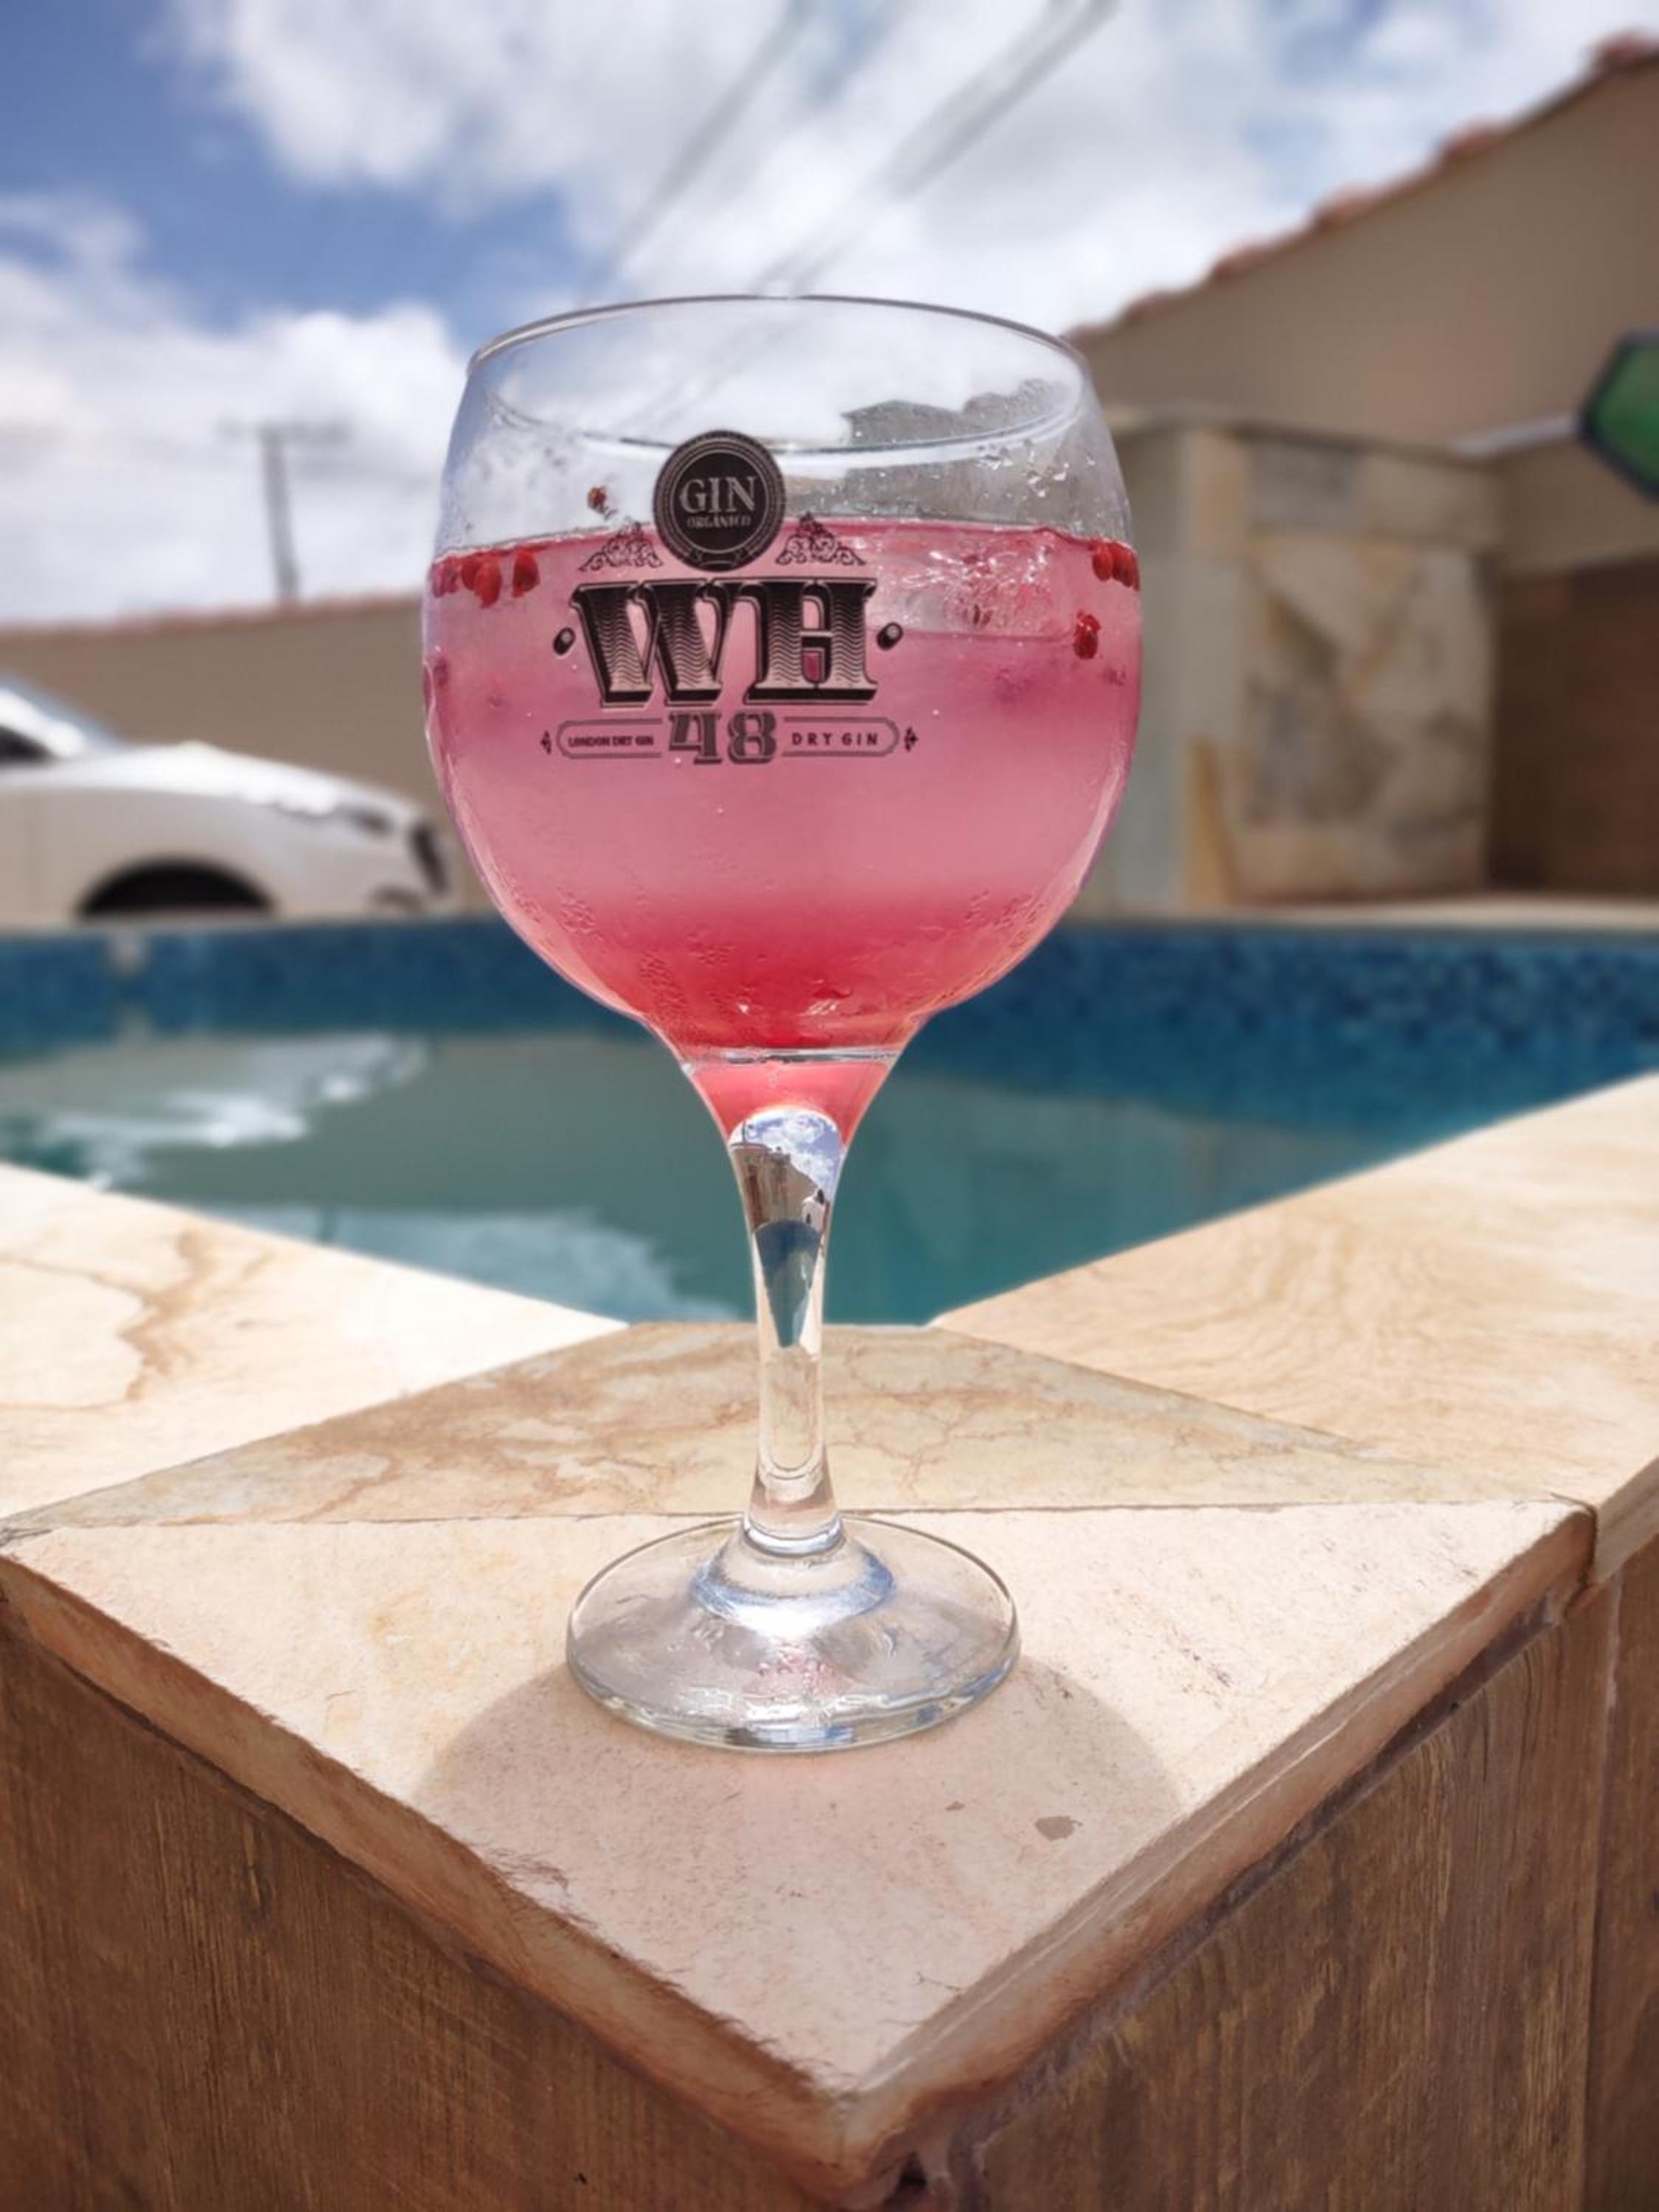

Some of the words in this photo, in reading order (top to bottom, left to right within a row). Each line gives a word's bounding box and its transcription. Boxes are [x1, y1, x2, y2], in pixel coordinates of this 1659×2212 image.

[679, 476, 757, 513] GIN
[568, 577, 878, 707] WH
[669, 711, 777, 765] 48
[791, 732, 832, 746] DRY
[841, 732, 879, 746] GIN
